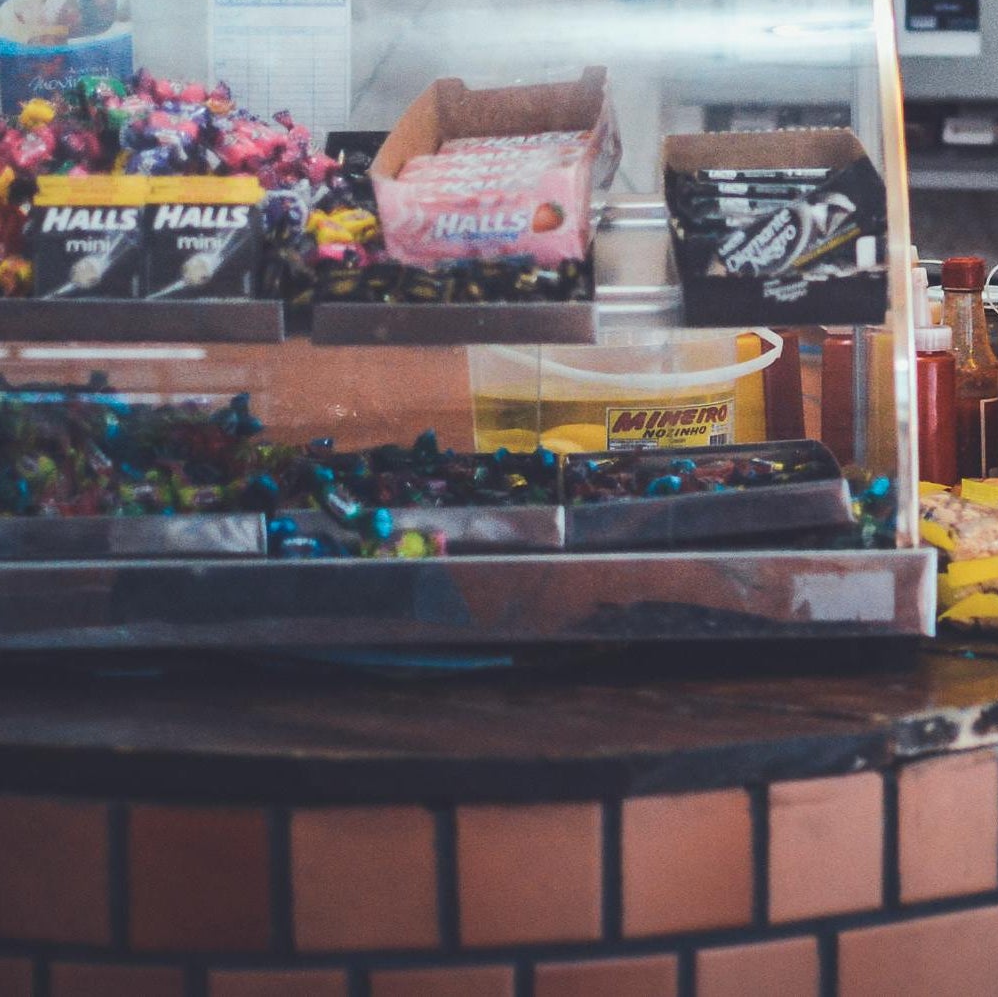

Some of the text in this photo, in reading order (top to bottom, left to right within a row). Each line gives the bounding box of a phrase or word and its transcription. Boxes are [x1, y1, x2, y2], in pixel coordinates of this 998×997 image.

[42, 207, 139, 233] HALLS
[153, 204, 251, 230] HALLS
[433, 209, 529, 238] HALLS
[65, 234, 111, 253] mini
[176, 232, 222, 251] mini
[611, 404, 729, 434] MINEIRO
[642, 425, 708, 439] NOZINHO
